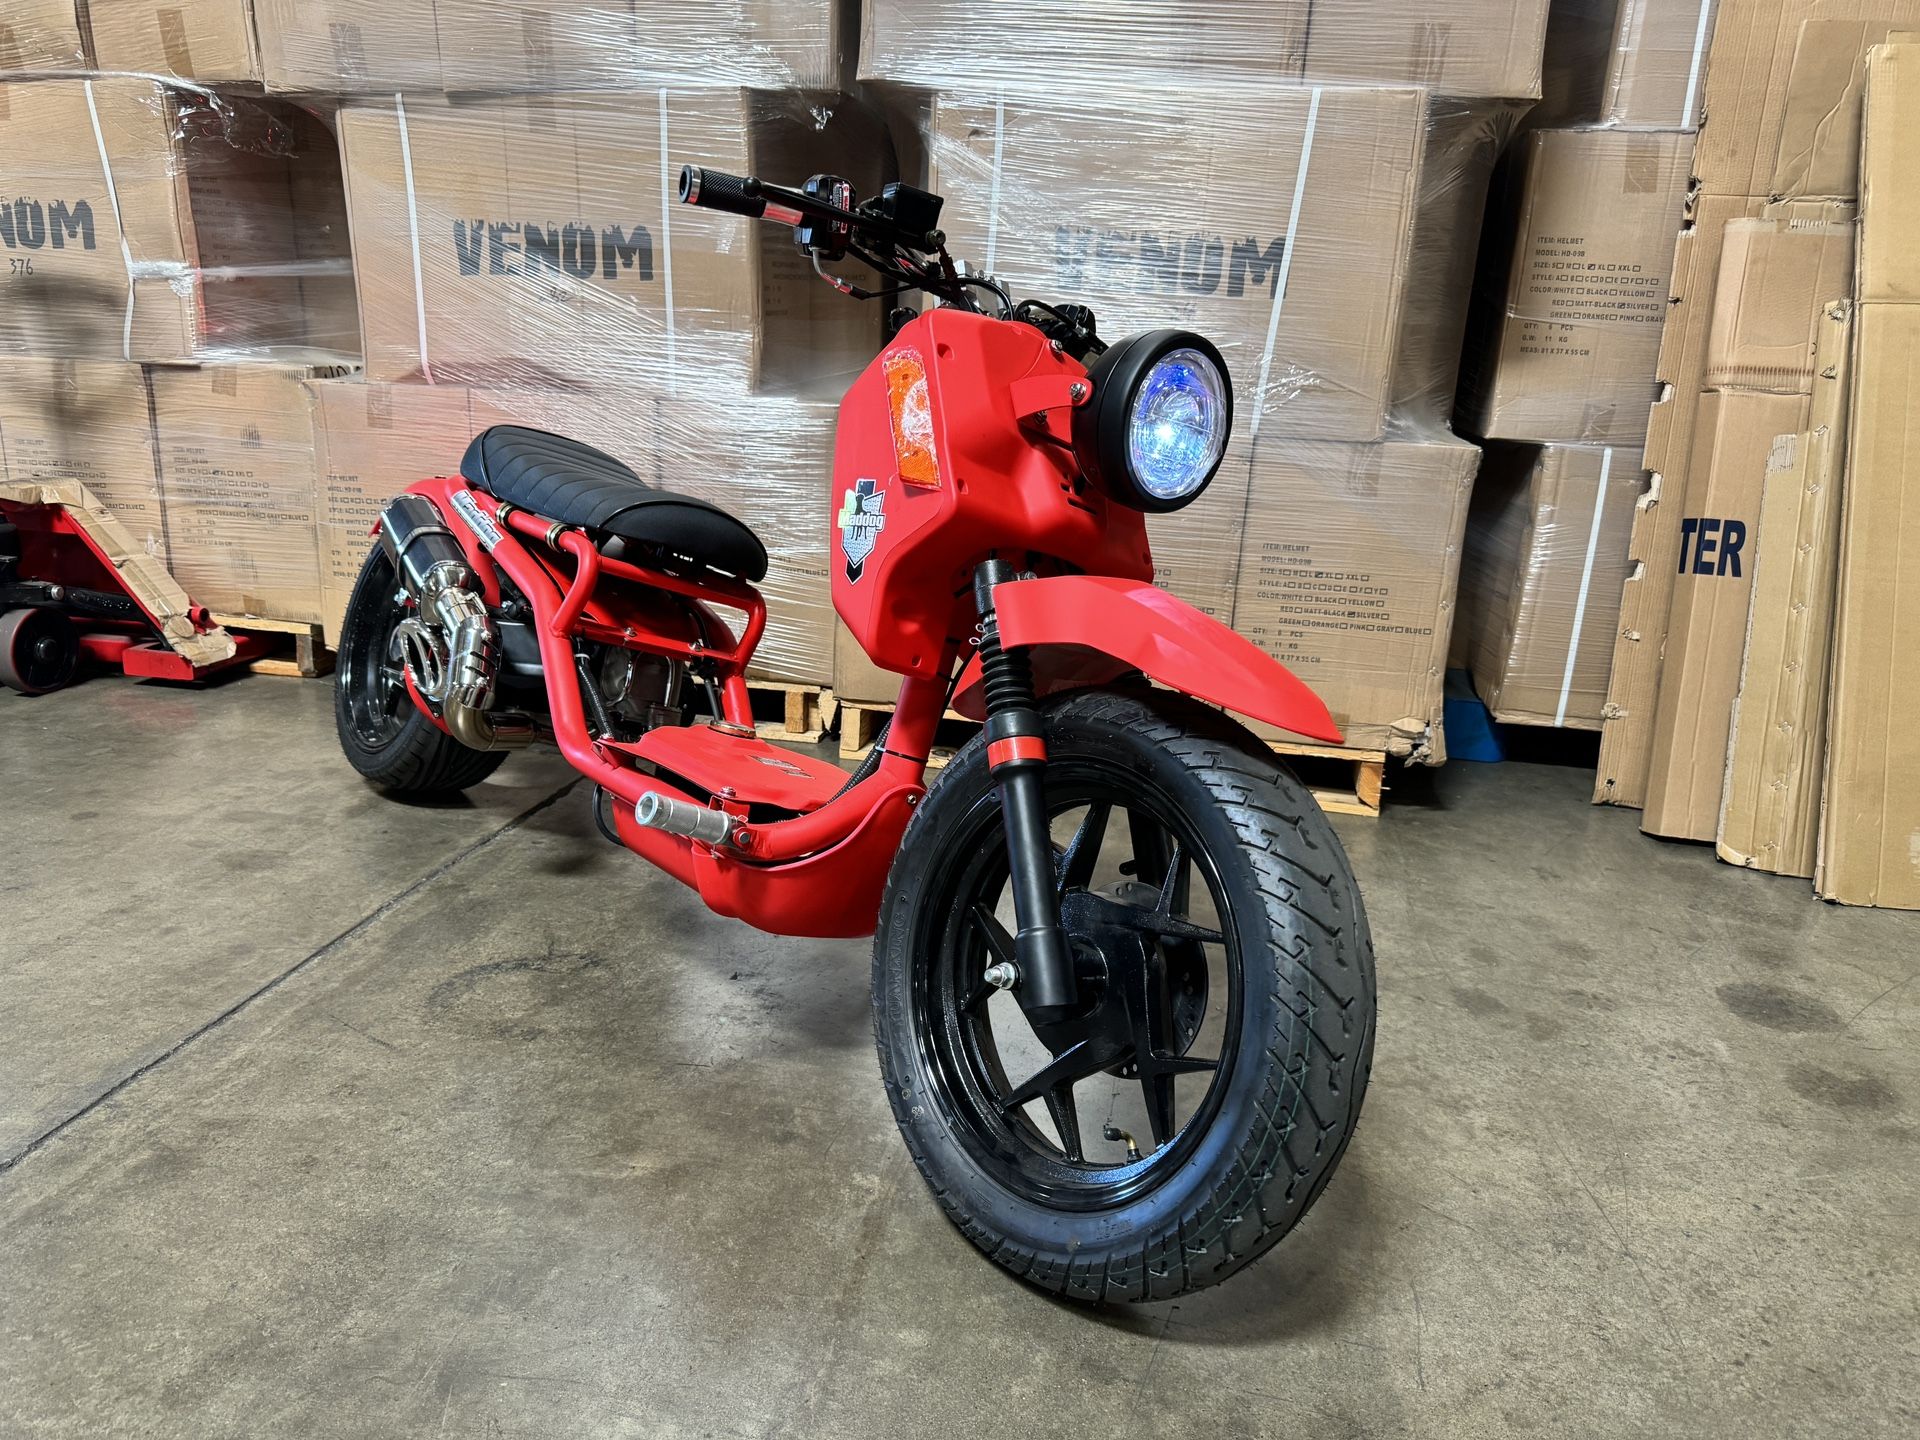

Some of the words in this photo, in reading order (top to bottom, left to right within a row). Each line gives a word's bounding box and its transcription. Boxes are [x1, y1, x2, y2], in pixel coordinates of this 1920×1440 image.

[452, 219, 654, 281] VENOM
[9, 258, 34, 276] 376
[1056, 226, 1287, 299] VENOM
[1586, 288, 1608, 296] BLACK
[1574, 300, 1616, 308] MATT-BLACK
[1626, 302, 1650, 310] SILVER
[839, 510, 885, 531] Maddog
[1678, 518, 1746, 578] TER
[1315, 596, 1336, 604] BLACK
[1348, 598, 1375, 607] YELLOW
[1304, 608, 1346, 617] MATT-BLACK
[1356, 612, 1380, 620] SILVER
[1312, 620, 1340, 628] ORANGE
[1350, 623, 1366, 631] PINK
[1376, 625, 1395, 633] GRAY
[1405, 627, 1423, 635] BLUE
